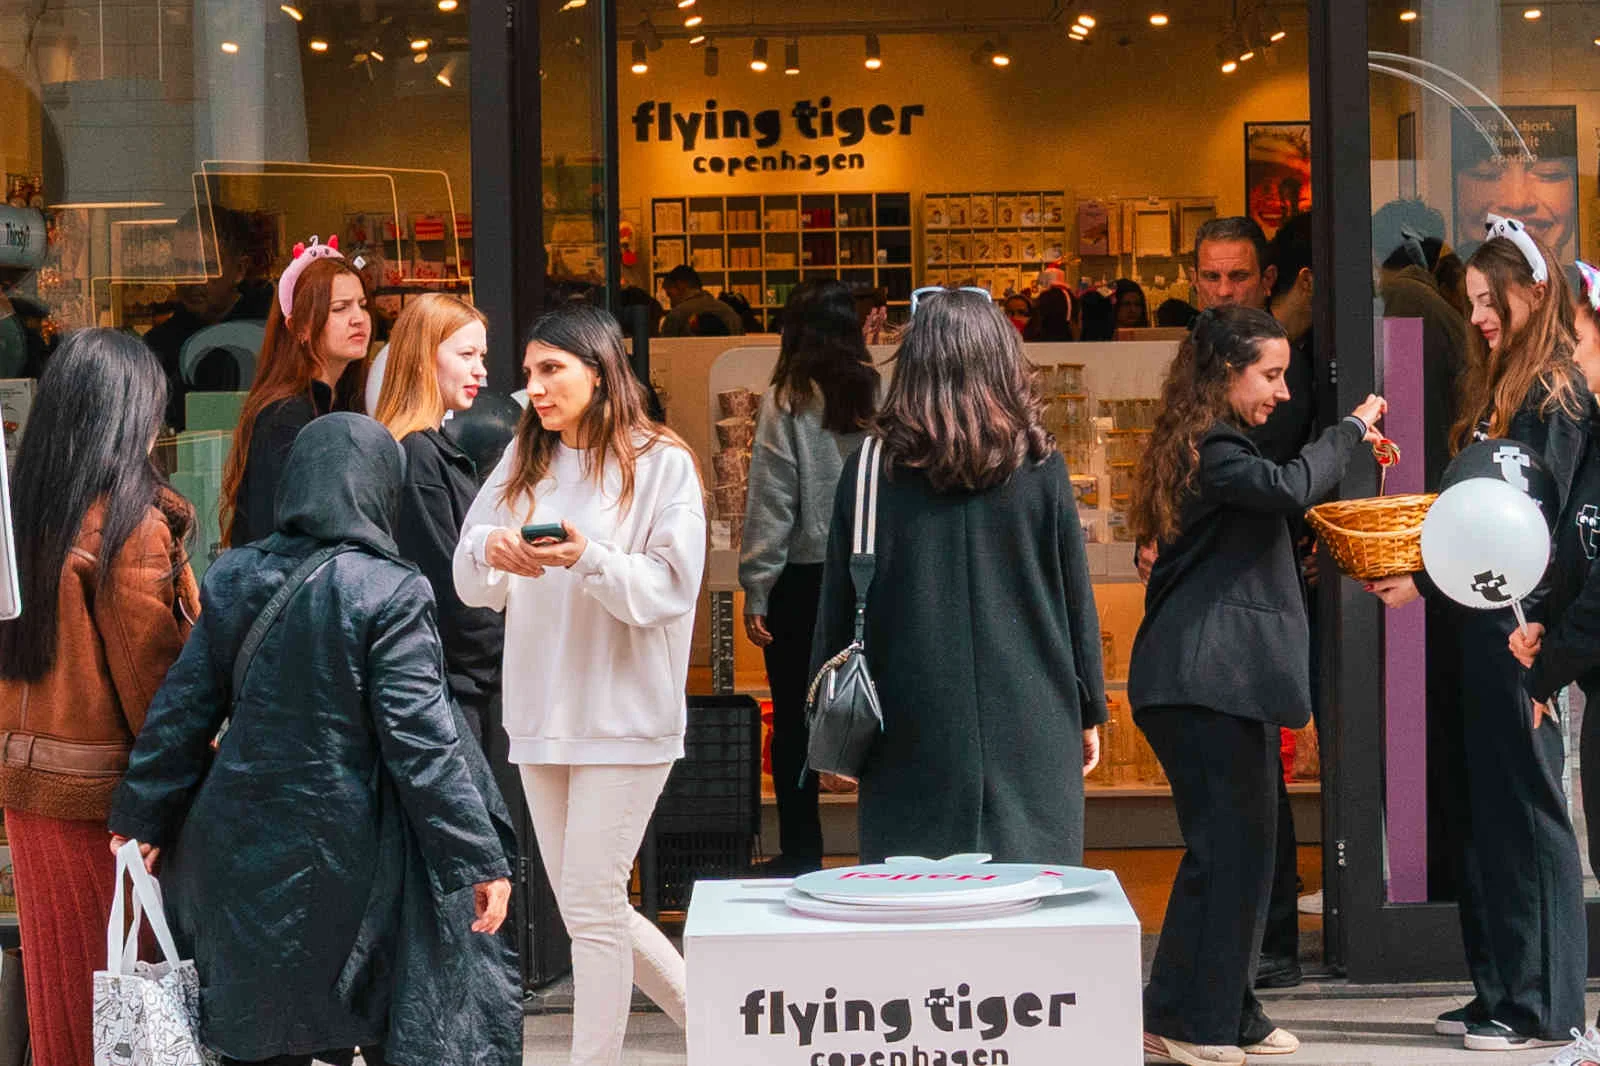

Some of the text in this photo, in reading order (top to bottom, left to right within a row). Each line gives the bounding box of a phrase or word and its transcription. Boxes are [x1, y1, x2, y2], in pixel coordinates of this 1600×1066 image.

[632, 96, 925, 151] flying tiger
[693, 150, 865, 176] copenhagen
[739, 983, 1077, 1047] flying tiger
